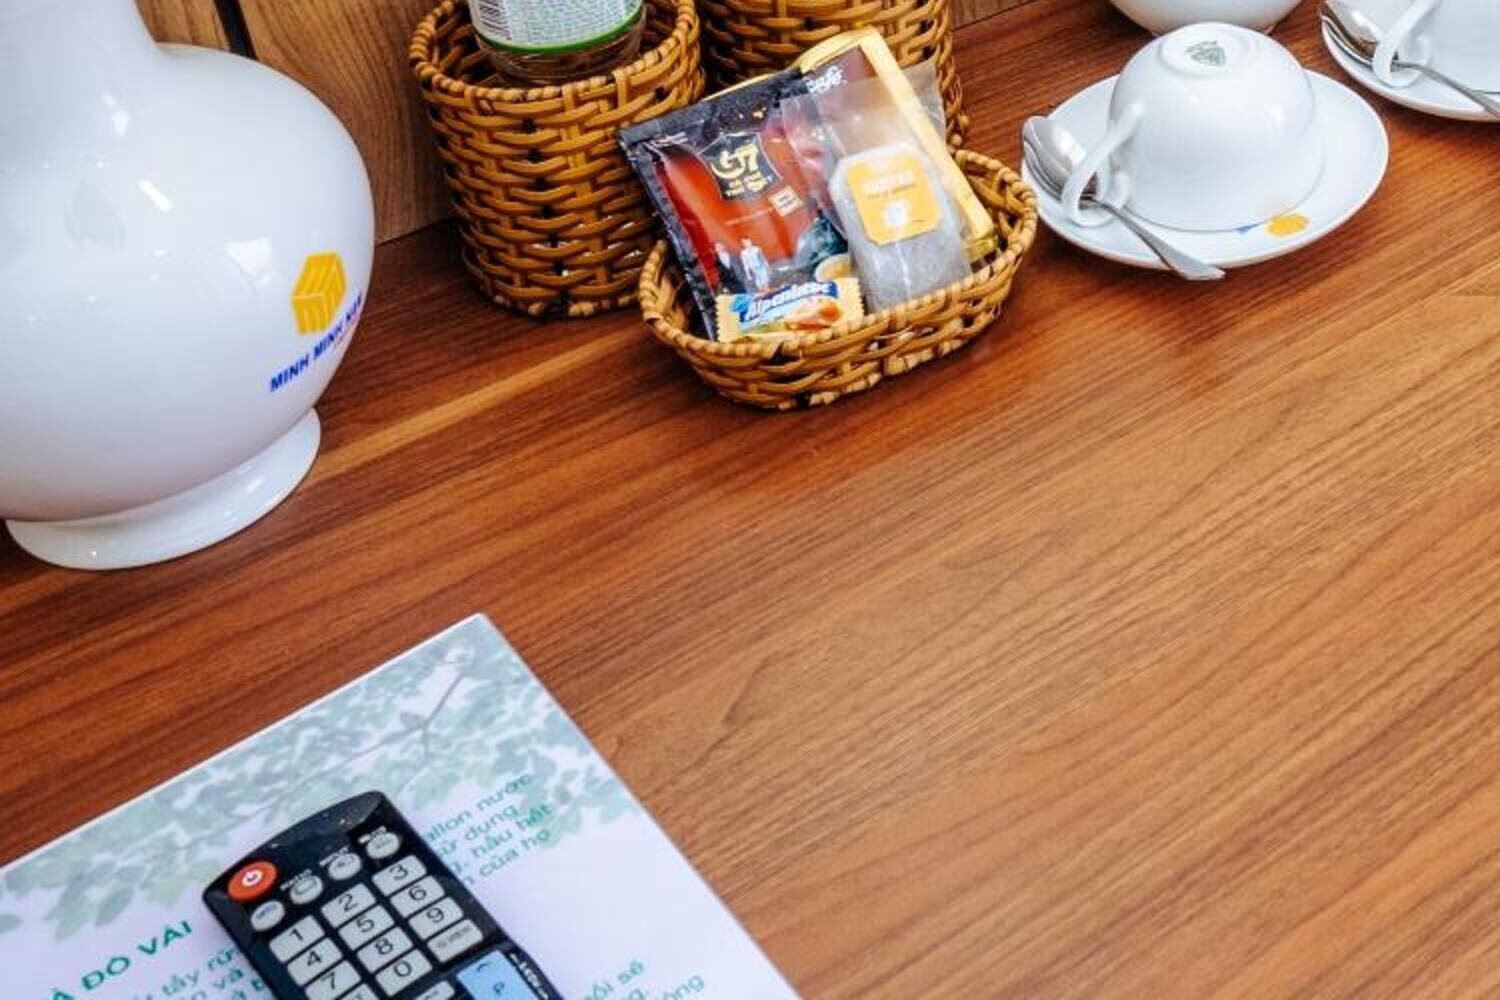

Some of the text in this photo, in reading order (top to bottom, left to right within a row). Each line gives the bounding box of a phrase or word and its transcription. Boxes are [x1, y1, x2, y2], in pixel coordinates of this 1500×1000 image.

[270, 353, 309, 392] MINH
[390, 865, 408, 880] 3
[409, 886, 427, 900] 6
[339, 894, 359, 912] 2
[427, 908, 444, 923] 9
[356, 918, 375, 933] 5
[290, 929, 304, 941] 1
[375, 939, 393, 956] 8
[307, 951, 321, 966] 4
[393, 962, 412, 977] 0
[321, 972, 337, 990] 7
